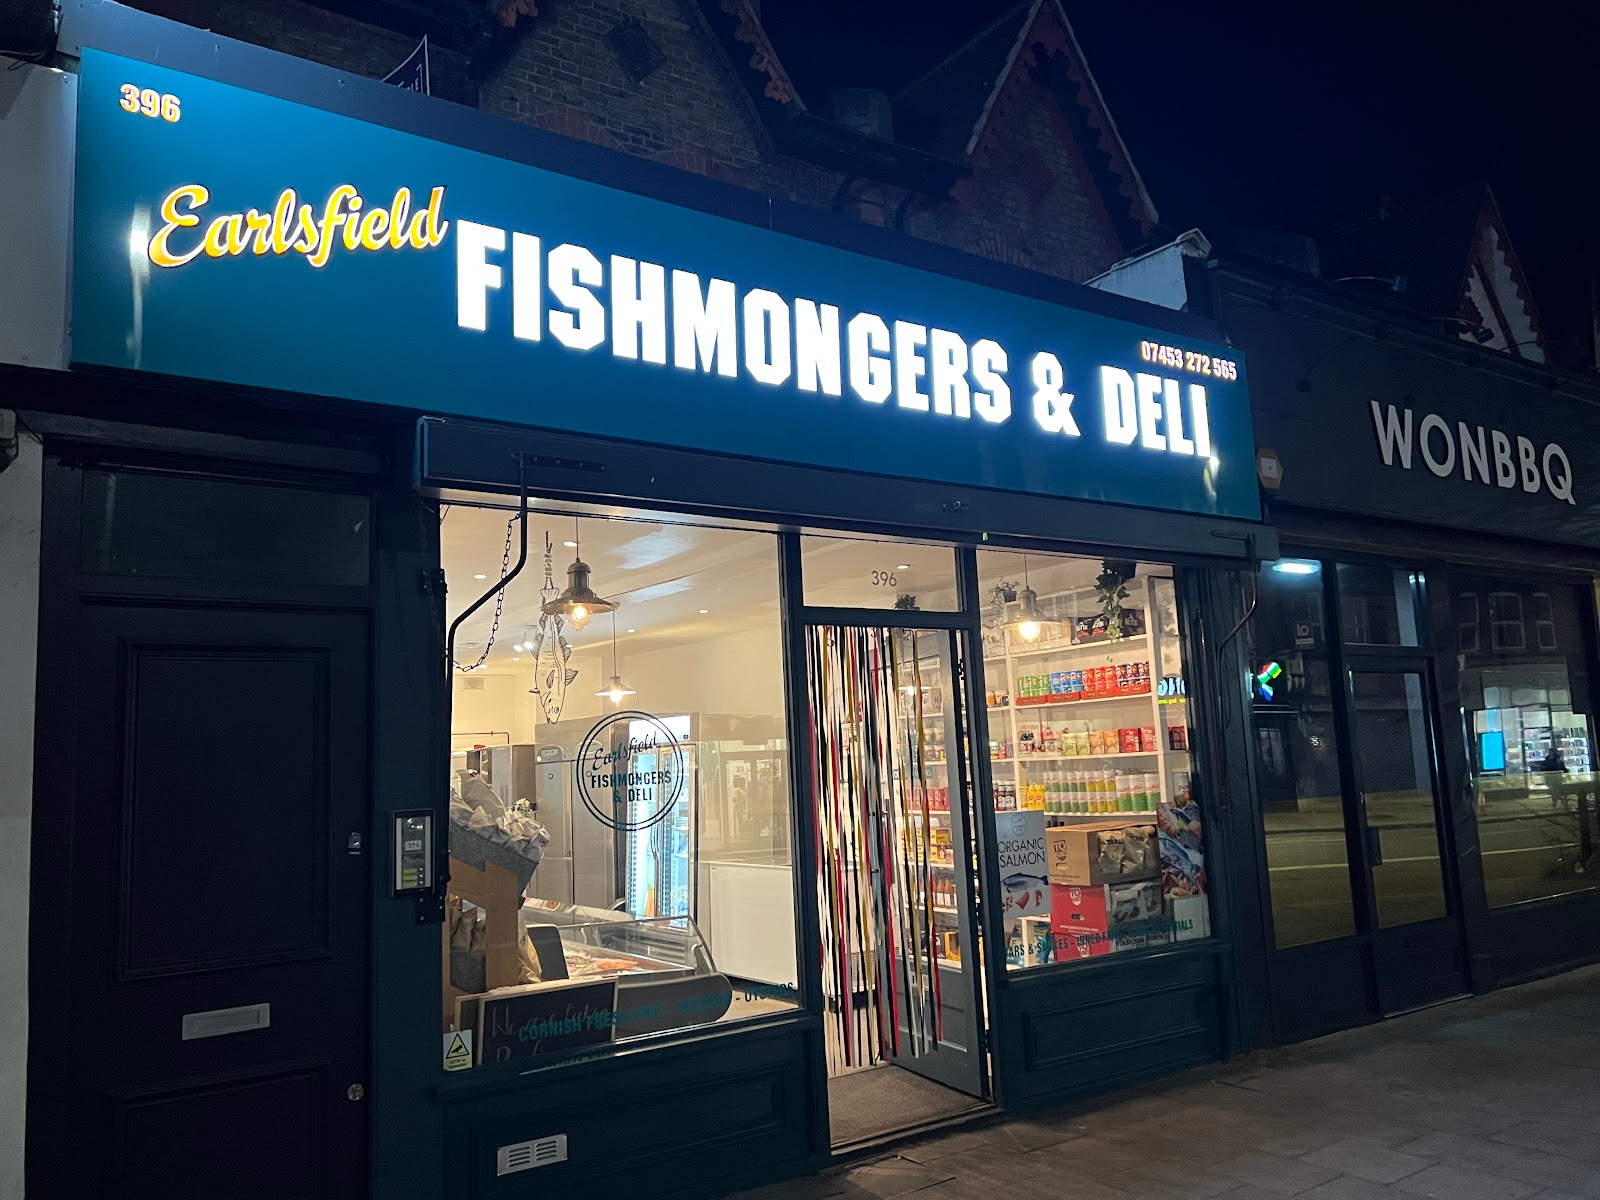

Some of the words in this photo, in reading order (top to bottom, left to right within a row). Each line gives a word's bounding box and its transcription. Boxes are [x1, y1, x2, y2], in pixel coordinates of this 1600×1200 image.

[119, 83, 181, 123] 396
[148, 183, 449, 269] Earlsfield
[456, 218, 1012, 425] FISHMONGERS
[1032, 351, 1081, 437] &
[1100, 365, 1211, 458] DELI
[1140, 340, 1184, 369] 07453
[1185, 350, 1212, 376] 272
[1212, 357, 1237, 381] 565
[1371, 400, 1577, 505] WONBBQ
[871, 570, 897, 587] 396
[592, 731, 657, 770] Earlsfield
[591, 770, 671, 788] FISHMONGERS
[628, 787, 652, 802] DELI
[998, 837, 1044, 853] ORGANIC
[1000, 851, 1045, 868] SALMON
[1036, 937, 1069, 954] SACES
[518, 1014, 583, 1042] CORNISH
